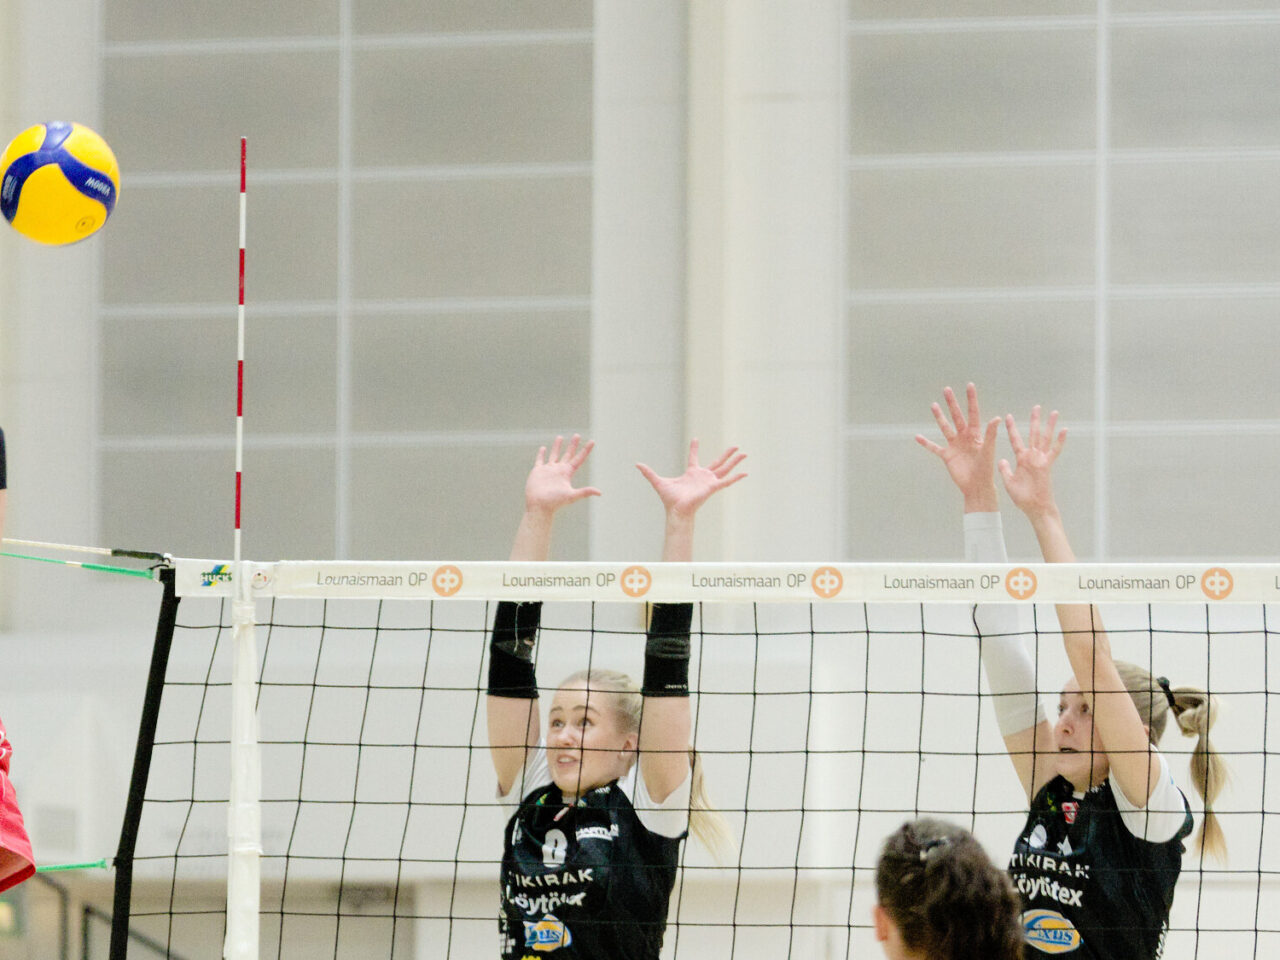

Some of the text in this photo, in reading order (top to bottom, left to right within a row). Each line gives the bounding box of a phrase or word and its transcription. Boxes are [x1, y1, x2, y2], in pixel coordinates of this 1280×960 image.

[317, 571, 427, 586] Lounaismaan OP
[502, 573, 616, 587] Lounaismaan OP
[692, 573, 806, 588] Lounaismaan OP
[884, 574, 1001, 589] Lounaismaan OP
[1078, 575, 1196, 590] Lounaismaan OP
